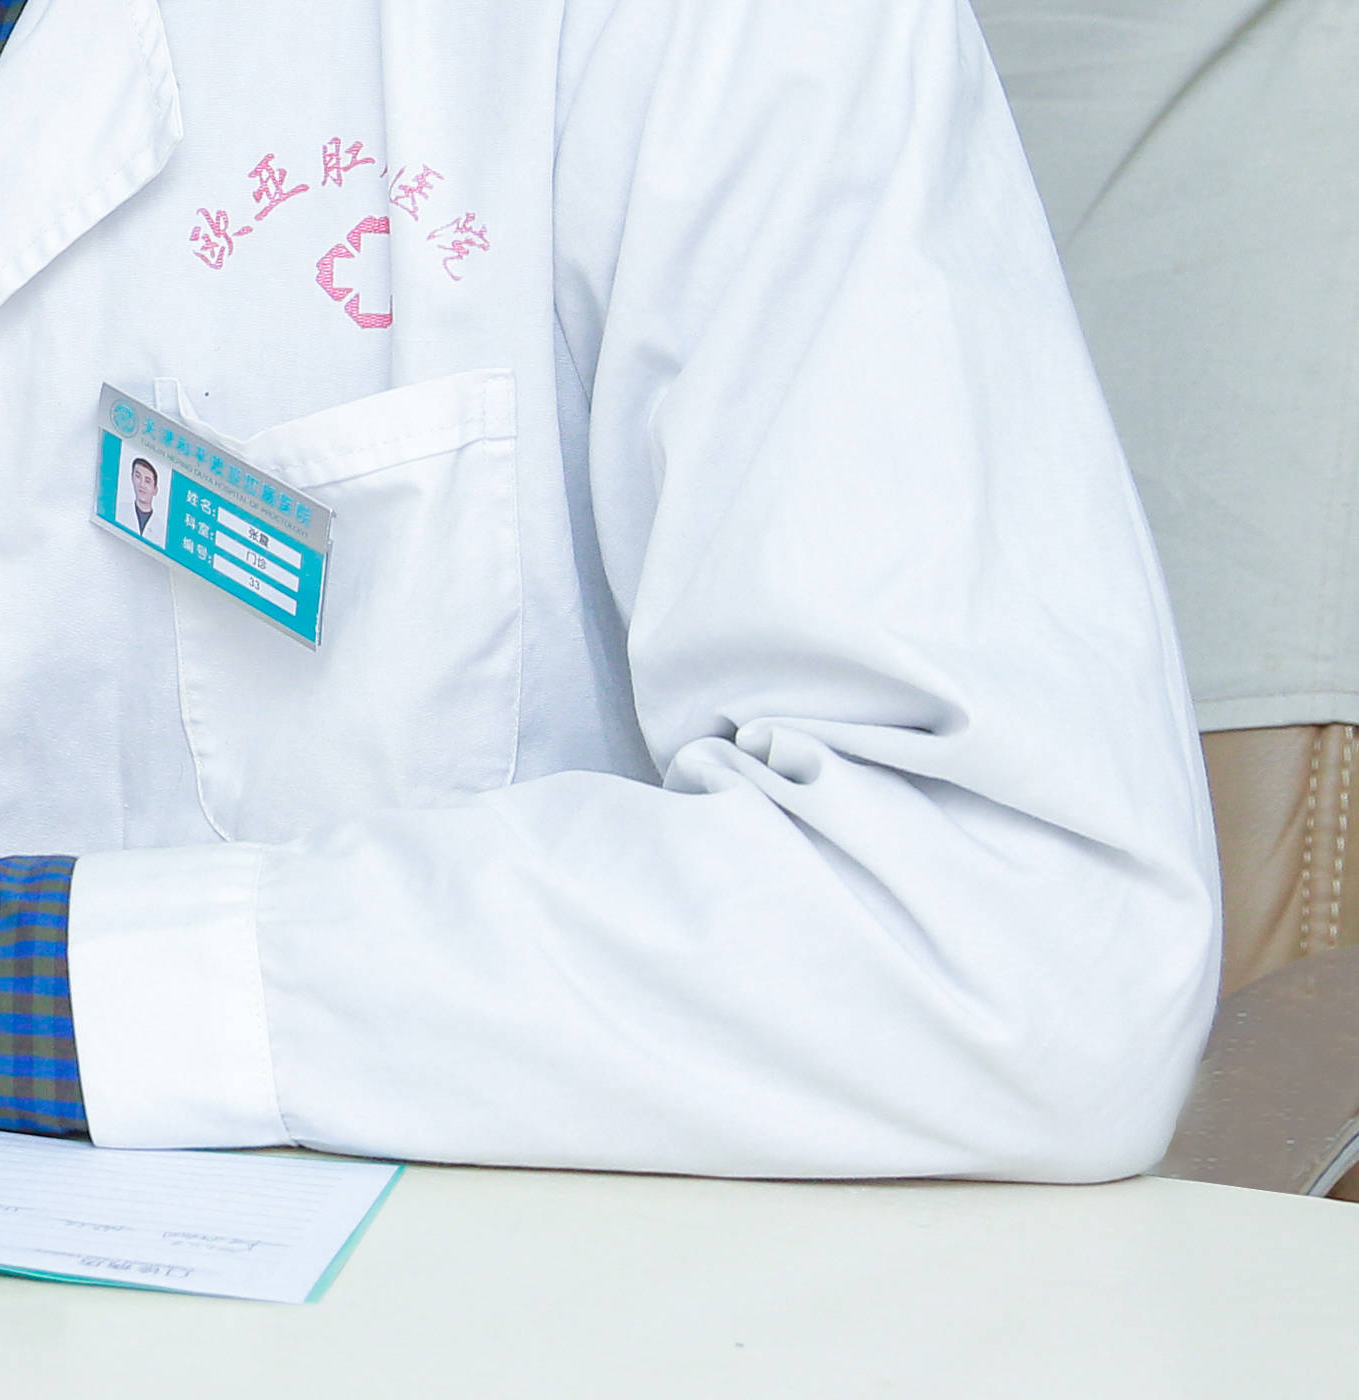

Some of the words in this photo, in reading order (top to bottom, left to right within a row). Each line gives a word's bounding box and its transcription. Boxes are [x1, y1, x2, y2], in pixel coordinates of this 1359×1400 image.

[190, 137, 490, 281] 欧亚肛医院
[249, 577, 260, 590] 33
